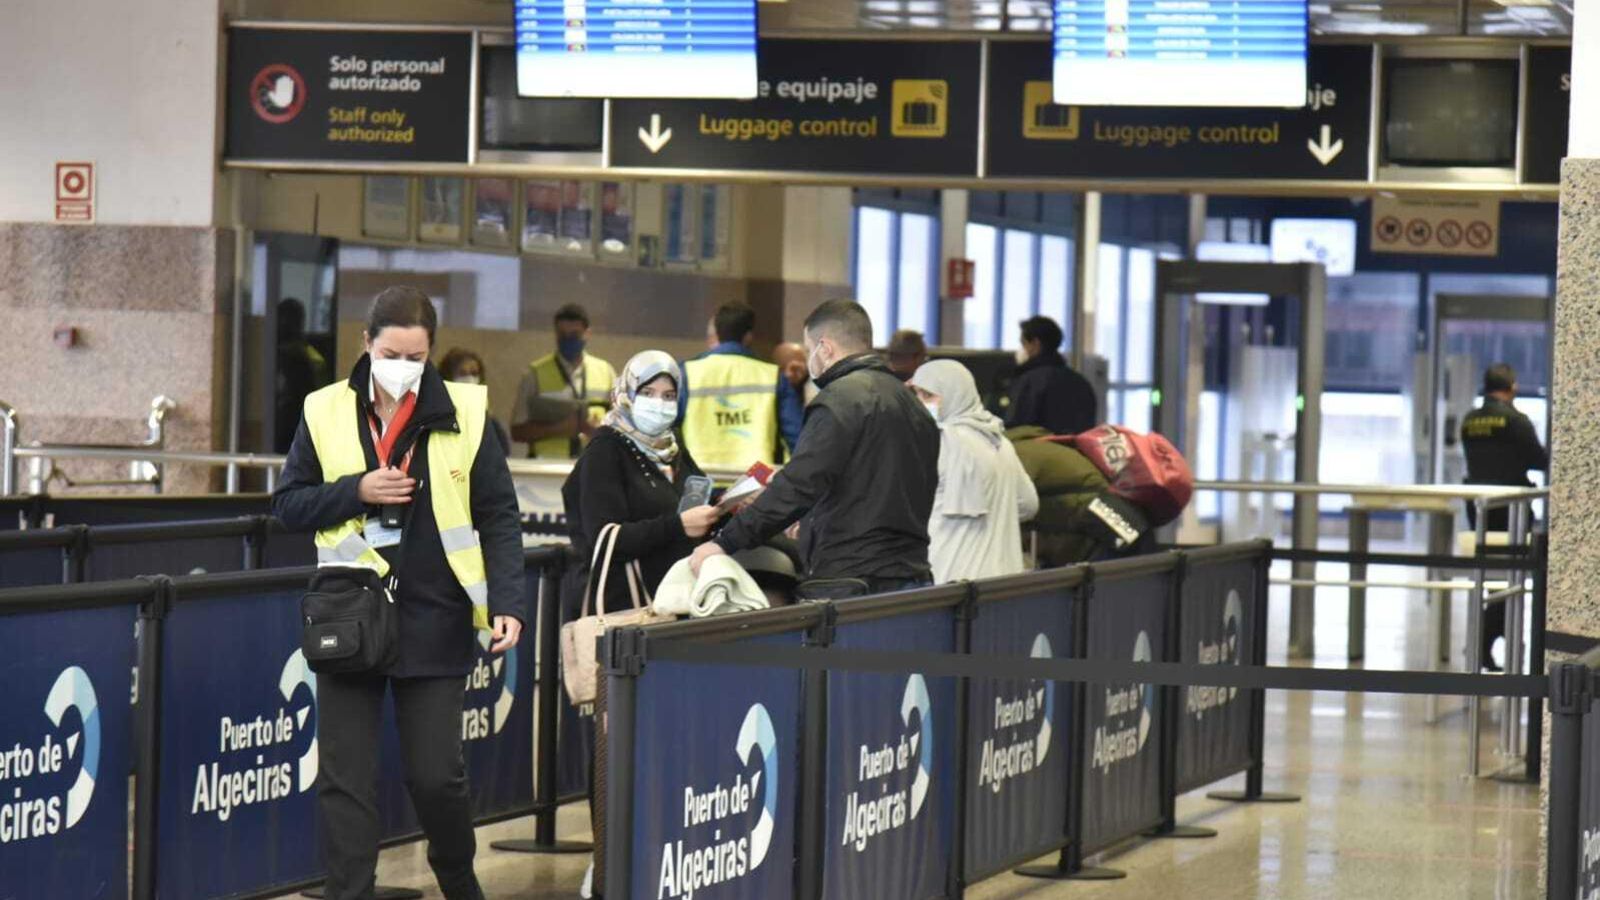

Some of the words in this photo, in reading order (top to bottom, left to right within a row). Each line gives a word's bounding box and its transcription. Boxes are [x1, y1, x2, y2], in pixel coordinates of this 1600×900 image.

[328, 75, 421, 91] autorizado
[329, 56, 368, 72] Solo
[371, 57, 445, 75] personal
[758, 80, 771, 96] e
[777, 77, 878, 103] equipaje
[328, 106, 366, 123] Staff
[371, 109, 405, 127] only
[328, 126, 415, 143] authorized
[699, 113, 794, 141] Luggage
[799, 115, 878, 137] control
[1093, 121, 1191, 147] Luggage
[1198, 122, 1280, 144] control
[714, 409, 752, 426] TME
[471, 657, 490, 690] de
[220, 714, 273, 753] Puerto
[275, 707, 293, 743] de
[994, 695, 1024, 731] Puerto
[0, 742, 34, 779] erto
[38, 733, 62, 774] de
[859, 743, 894, 782] Puerto
[896, 734, 909, 770] de
[979, 731, 1034, 793] Algeciras
[191, 754, 292, 822] Algeciras
[684, 783, 729, 828] Puerto
[730, 774, 749, 815] de
[0, 786, 61, 843] ciras
[842, 782, 906, 852] Algeciras
[657, 829, 748, 900] Algeciras
